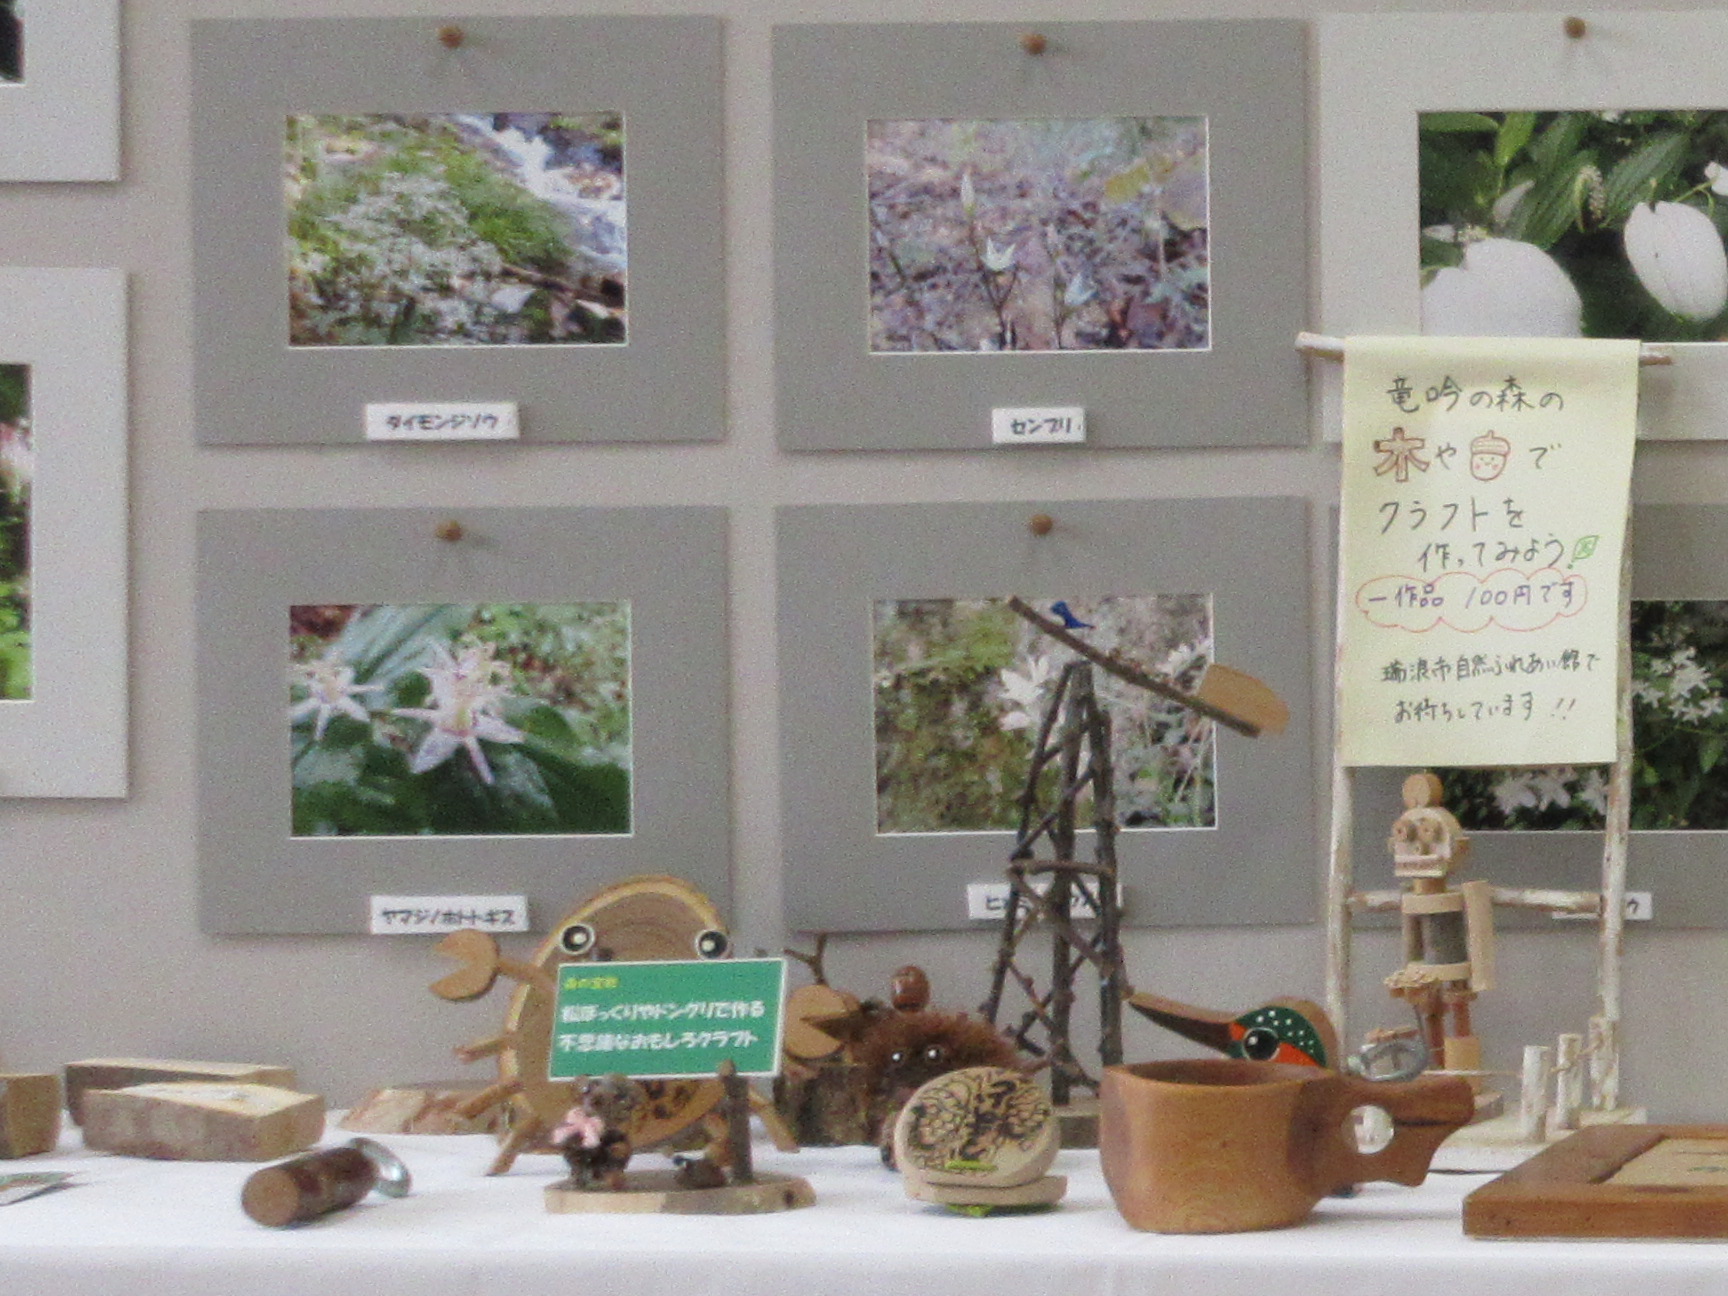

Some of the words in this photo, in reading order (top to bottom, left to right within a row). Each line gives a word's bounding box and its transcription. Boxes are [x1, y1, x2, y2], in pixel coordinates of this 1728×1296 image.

[1387, 375, 1564, 413] 竜吟の森の
[1379, 497, 1524, 534] クラフトを
[1381, 649, 1601, 683] 瑞浪市自然ふれあい館で
[382, 907, 515, 925] ヤマジノホトトギス
